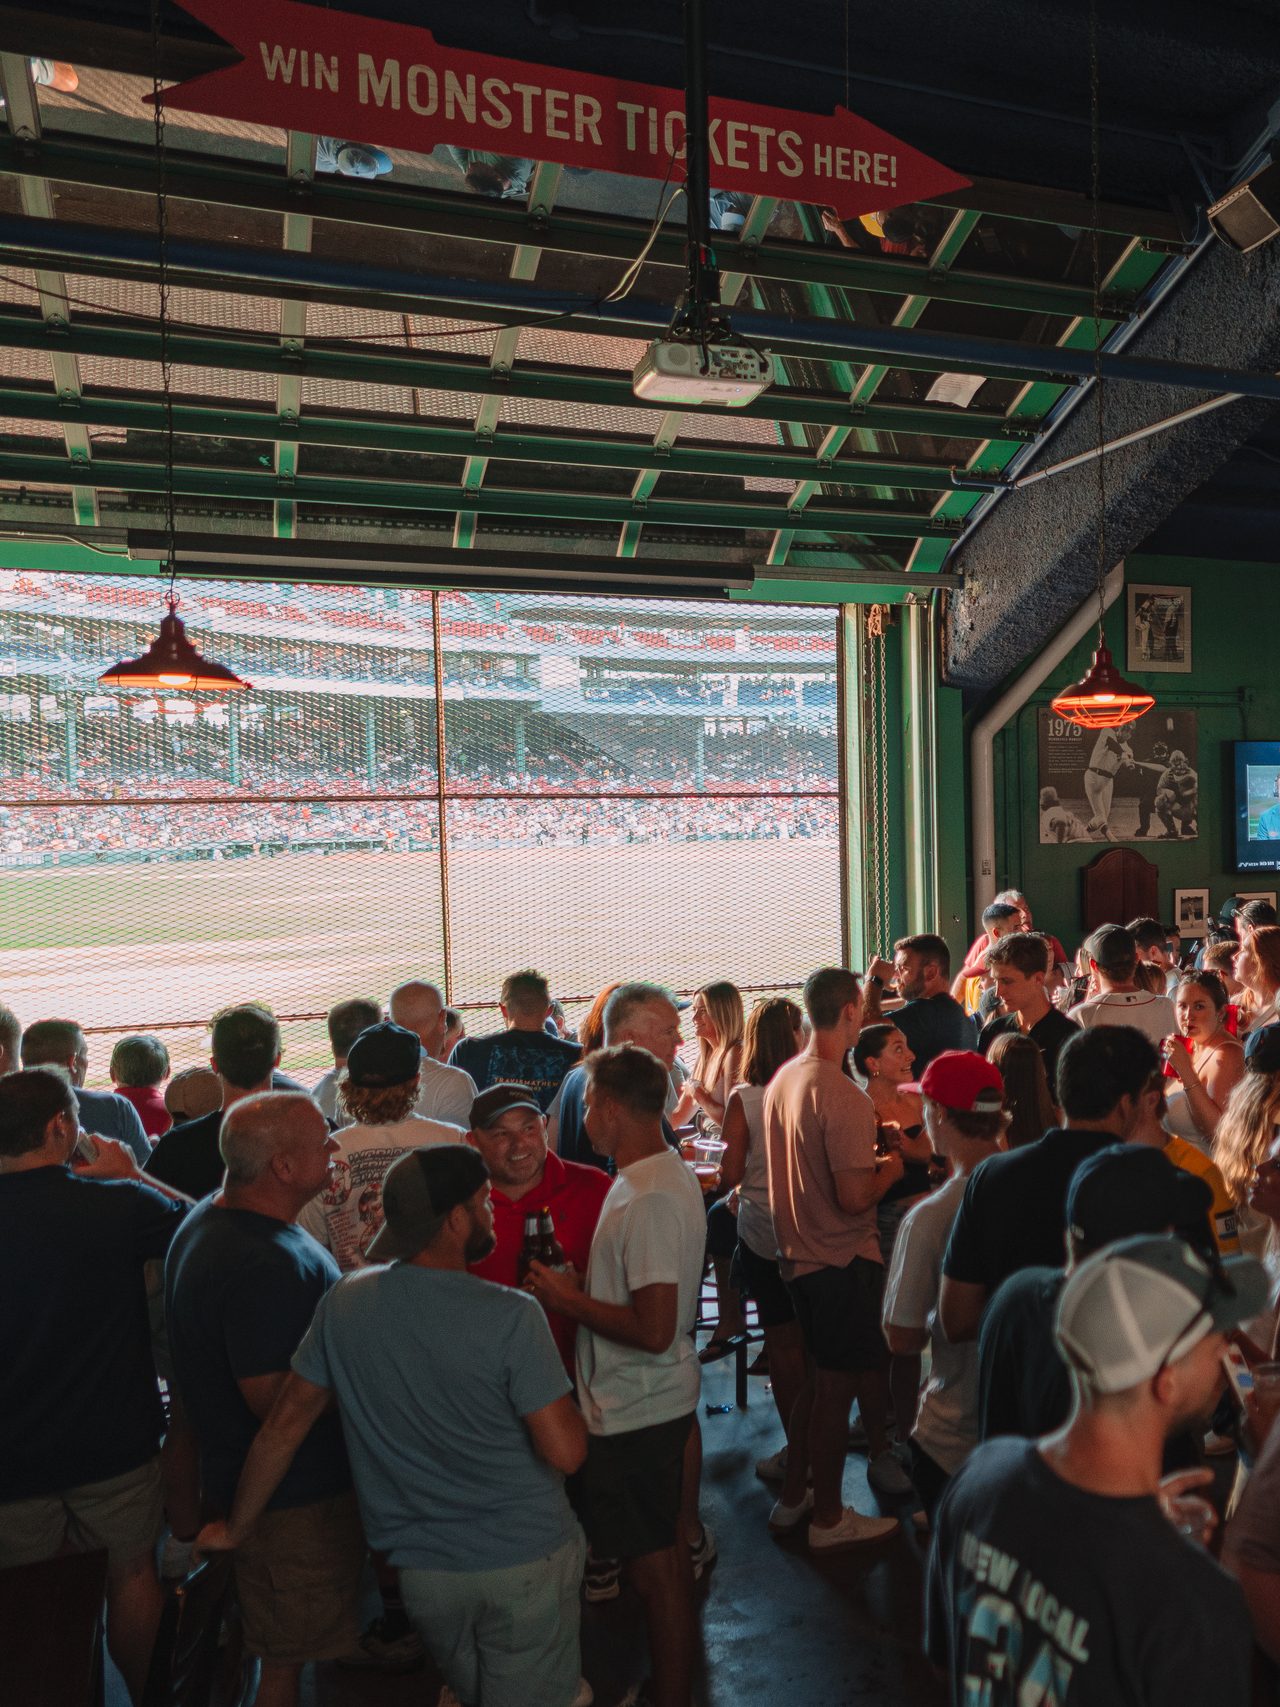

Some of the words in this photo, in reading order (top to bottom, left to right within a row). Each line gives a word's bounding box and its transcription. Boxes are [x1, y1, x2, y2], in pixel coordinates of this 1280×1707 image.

[259, 41, 339, 93] WIN
[358, 53, 603, 146] MONSTER
[616, 101, 804, 178] TICKETS
[813, 143, 897, 188] HERE!
[1047, 718, 1082, 737] 1975
[494, 1077, 558, 1087] TRAVISMATHEW
